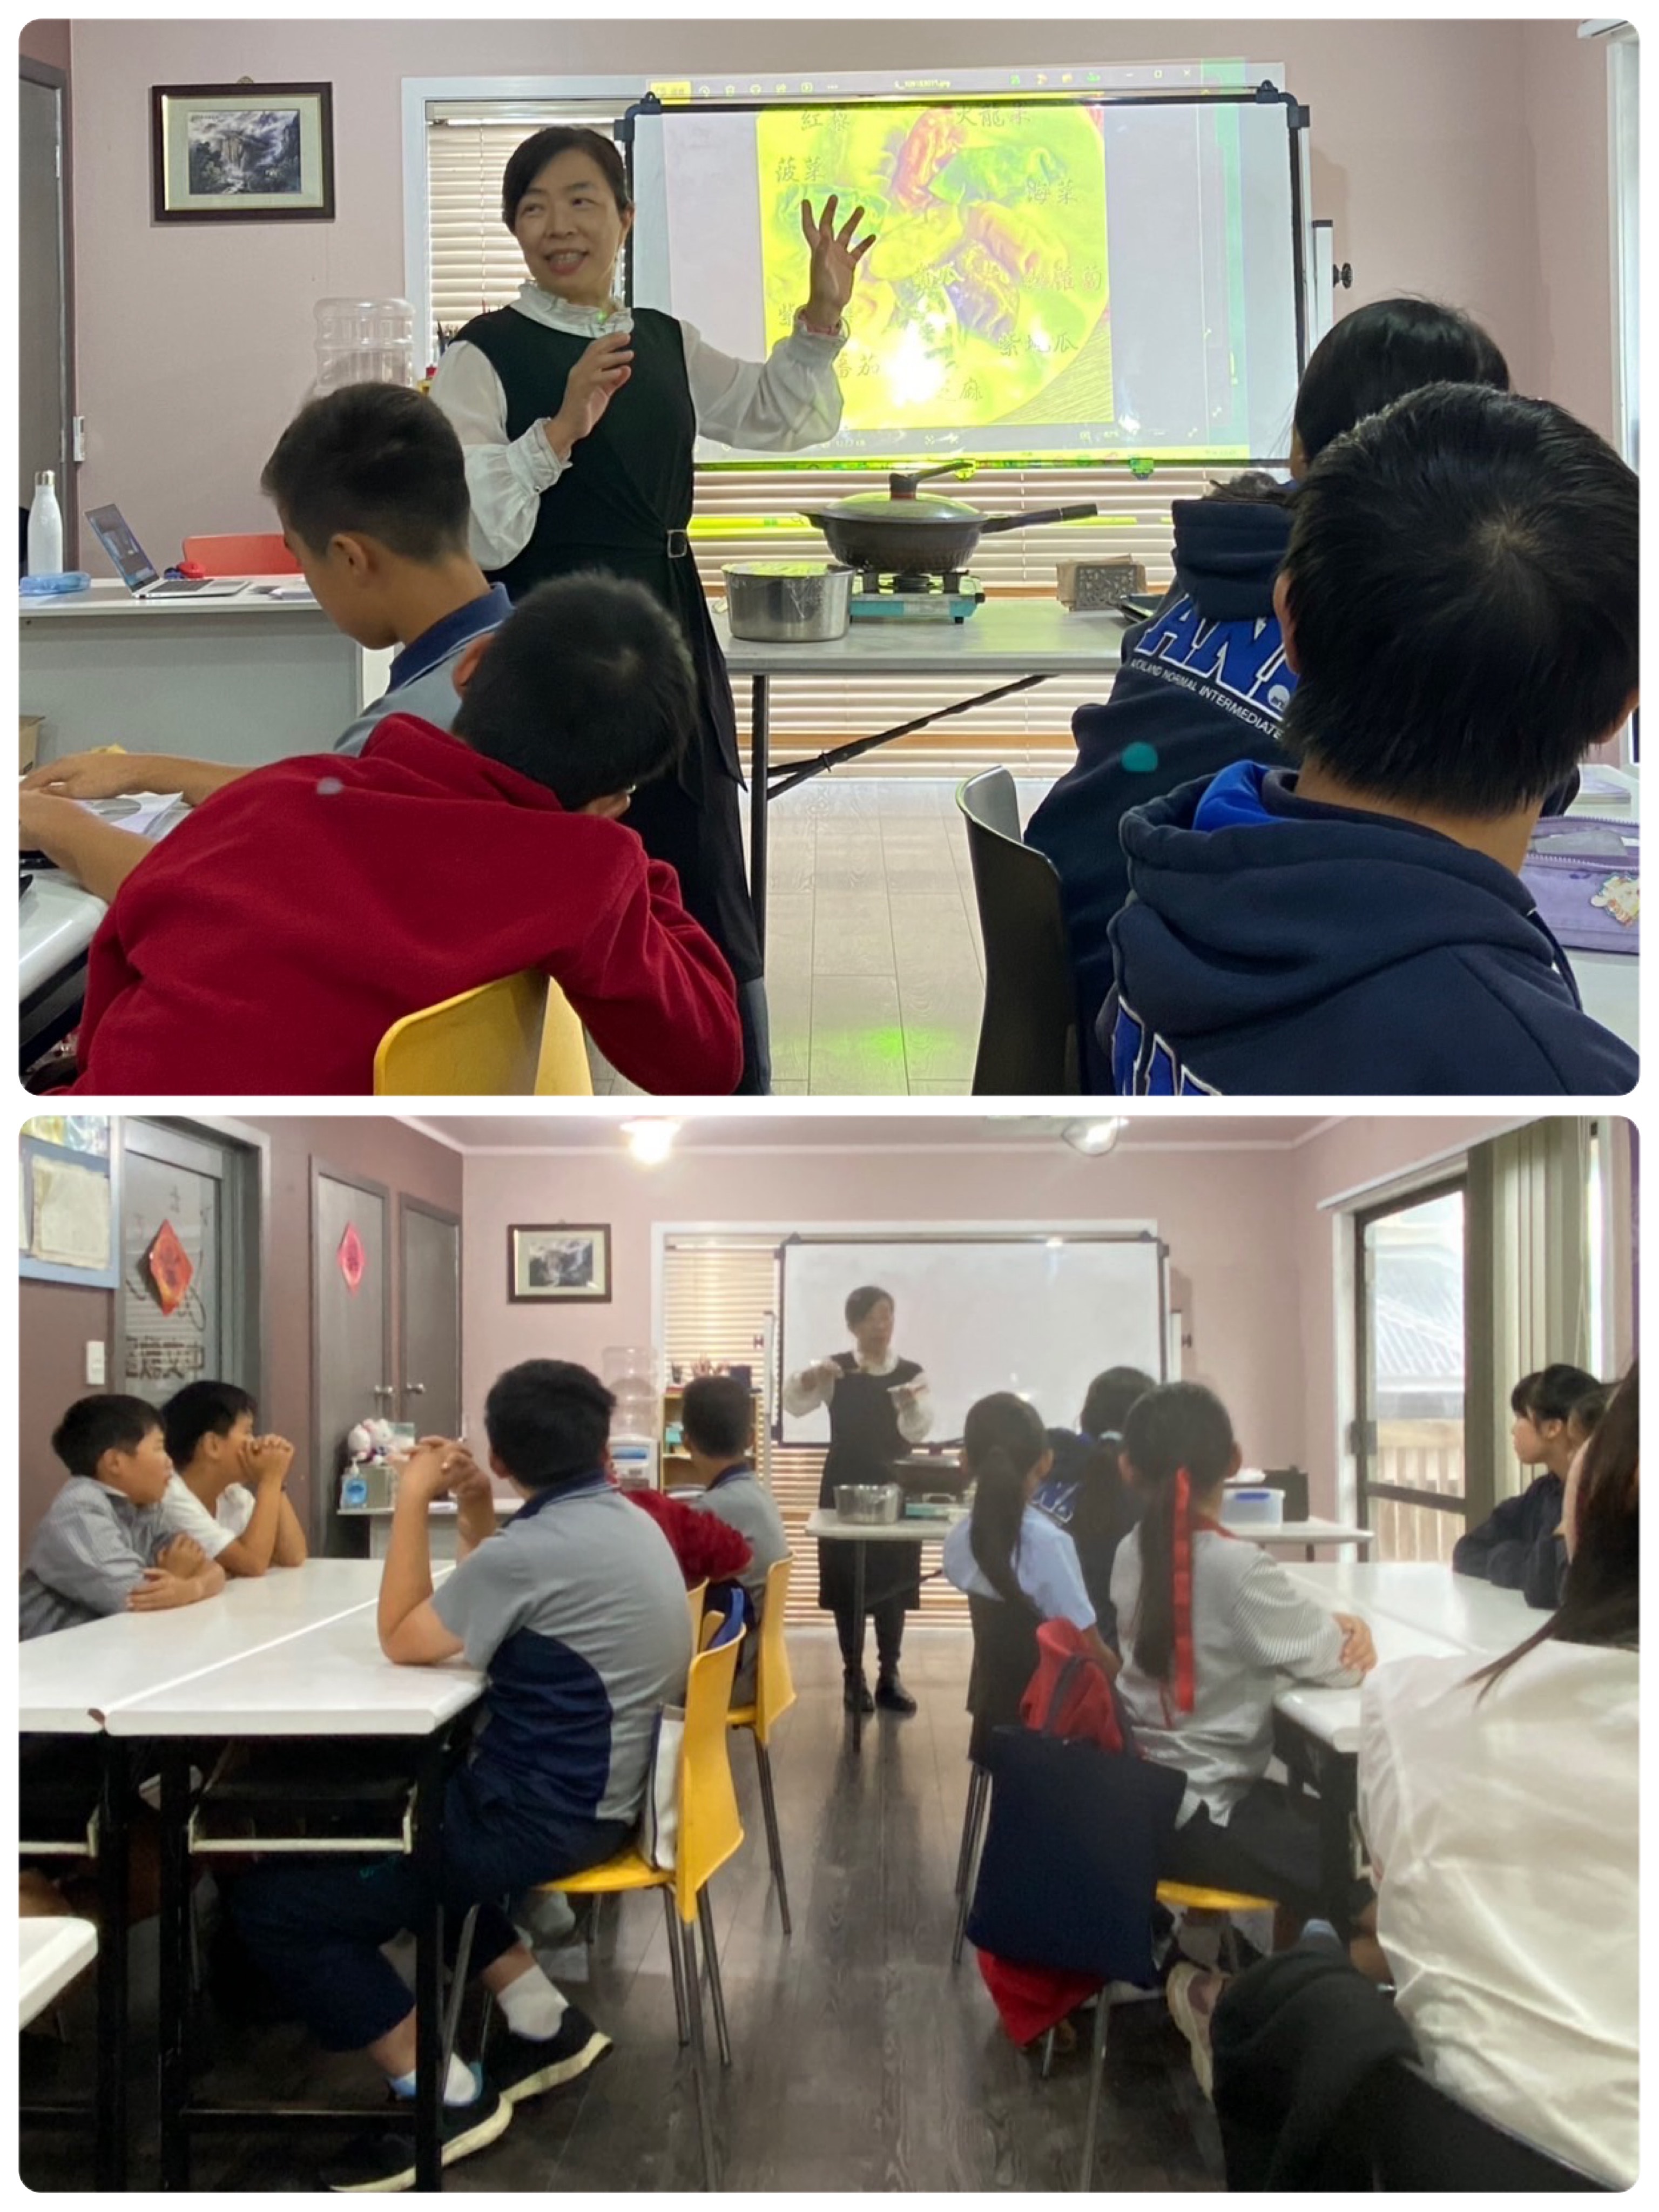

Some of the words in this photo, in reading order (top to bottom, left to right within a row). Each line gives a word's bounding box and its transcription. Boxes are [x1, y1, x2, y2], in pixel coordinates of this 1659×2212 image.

[775, 156, 826, 183] 菠菜
[1027, 178, 1078, 205] 海菜
[1162, 670, 1198, 692] NORMAL
[1198, 685, 1284, 740] INTERMEDIATE
